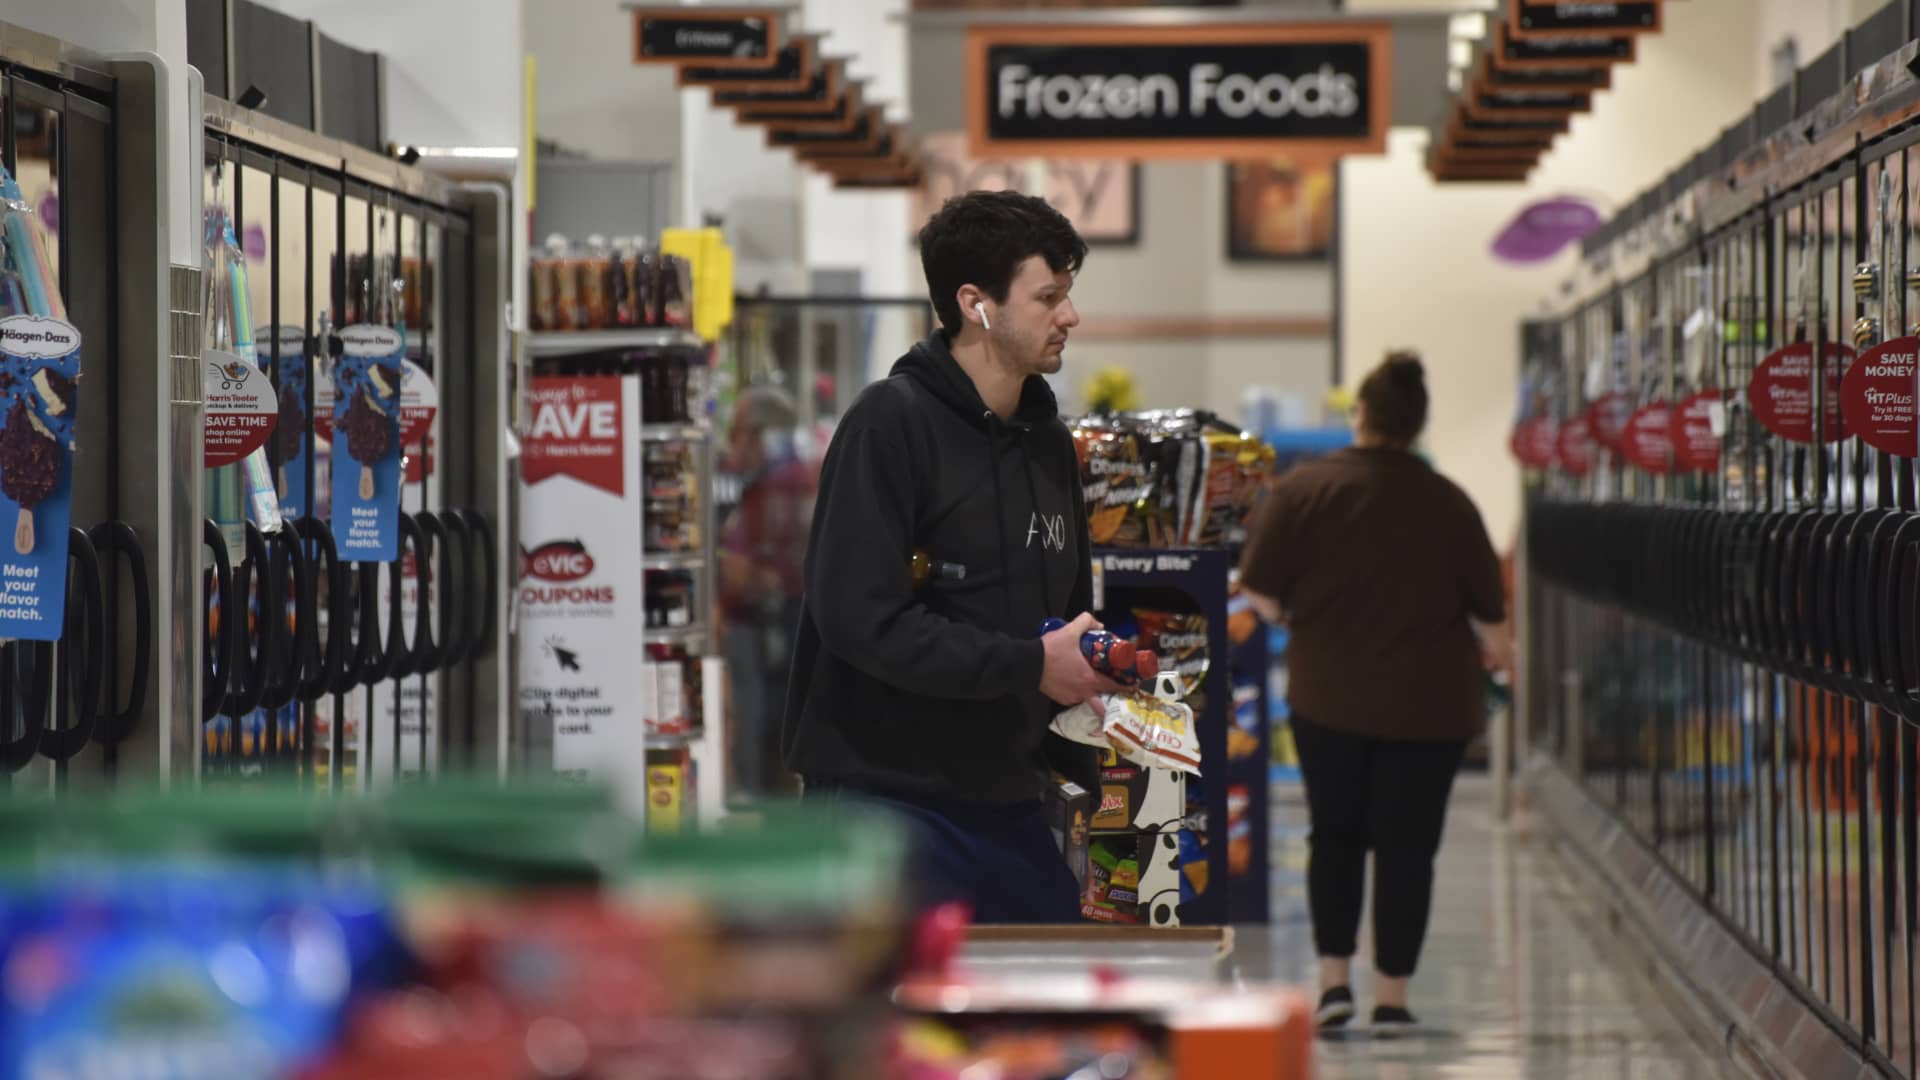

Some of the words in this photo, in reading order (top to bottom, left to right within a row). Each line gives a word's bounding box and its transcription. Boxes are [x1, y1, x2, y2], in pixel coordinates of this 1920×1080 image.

[999, 64, 1179, 119] Frozen
[1190, 63, 1360, 118] Foods
[1881, 353, 1915, 364] SAVE
[1865, 366, 1914, 377] MONEY
[1873, 406, 1887, 415] Try
[206, 416, 236, 427] SAVE
[239, 416, 268, 427] TIME
[526, 402, 618, 439] AVE
[1895, 414, 1913, 423] days
[205, 429, 225, 438] shop
[226, 428, 251, 436] online
[351, 507, 378, 517] Meet
[352, 520, 377, 530] your
[349, 528, 379, 538] flavor
[1104, 556, 1153, 573] Every
[3, 564, 39, 578] Meet
[4, 580, 36, 593] your
[520, 587, 615, 604] OUPONS
[1159, 634, 1208, 649] Dorito
